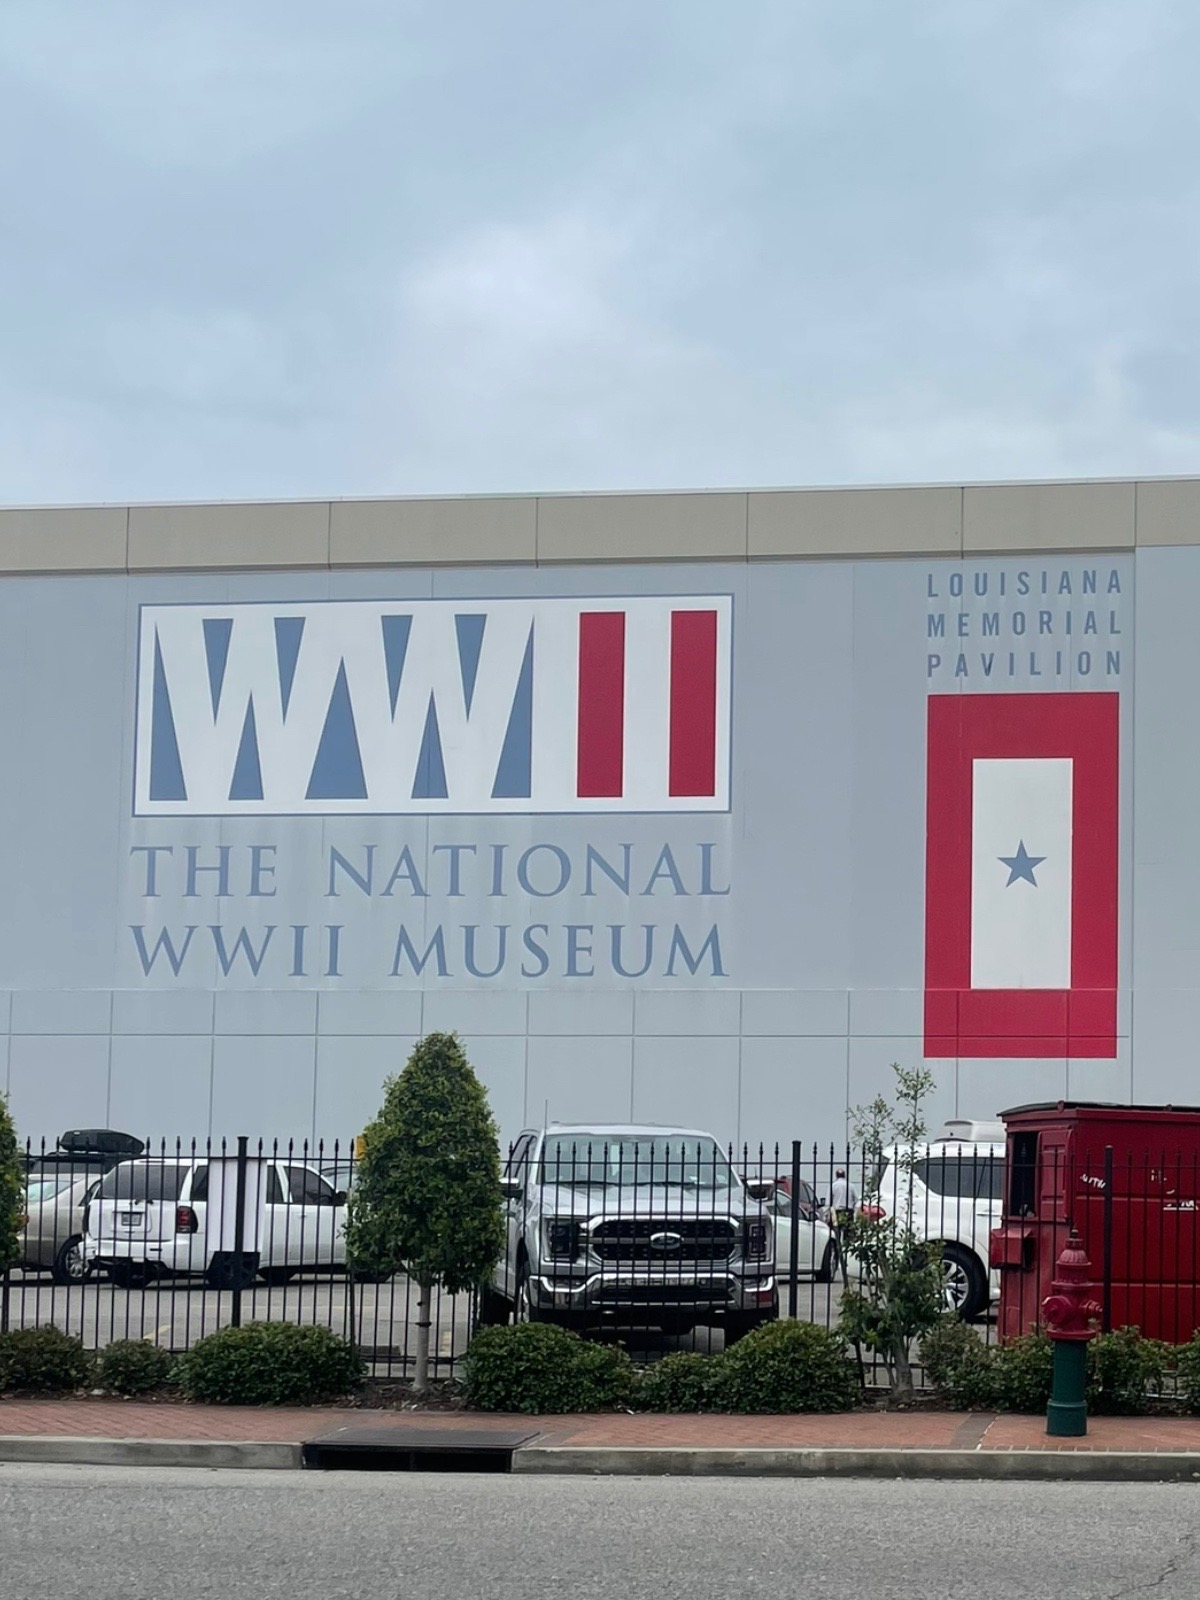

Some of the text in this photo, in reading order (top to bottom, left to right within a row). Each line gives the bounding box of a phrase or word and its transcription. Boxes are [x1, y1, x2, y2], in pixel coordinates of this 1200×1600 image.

[927, 569, 1121, 598] LOUISIANA
[927, 610, 1122, 638] MEMORIAL
[927, 651, 1121, 678] PAVILION
[147, 608, 720, 802] WWII
[130, 842, 732, 899] THE NATIONAL
[129, 923, 731, 978] WWII MUSEUM
